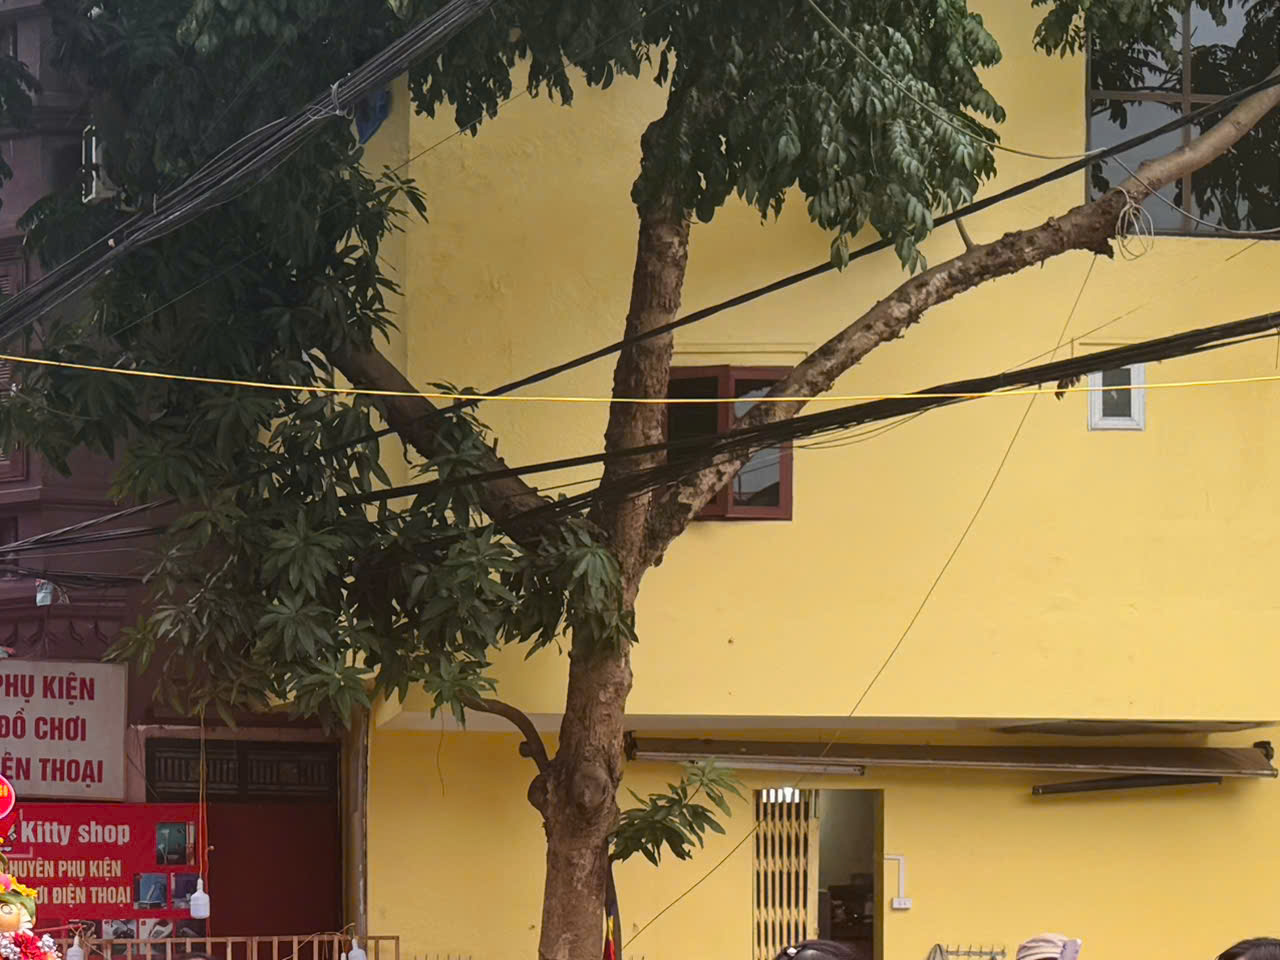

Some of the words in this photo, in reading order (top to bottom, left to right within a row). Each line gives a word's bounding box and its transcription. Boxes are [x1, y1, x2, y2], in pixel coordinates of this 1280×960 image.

[42, 671, 95, 705] KIỆN
[34, 715, 87, 741] CHƠI
[38, 758, 104, 788] THOẠI
[21, 820, 71, 845] Kitty
[78, 821, 131, 845] shop
[8, 857, 54, 878] HUYÊN
[58, 860, 85, 881] PHỤ
[89, 857, 121, 881] KIỆN
[52, 883, 85, 908] ĐIỆN
[90, 886, 131, 908] THOẠI
